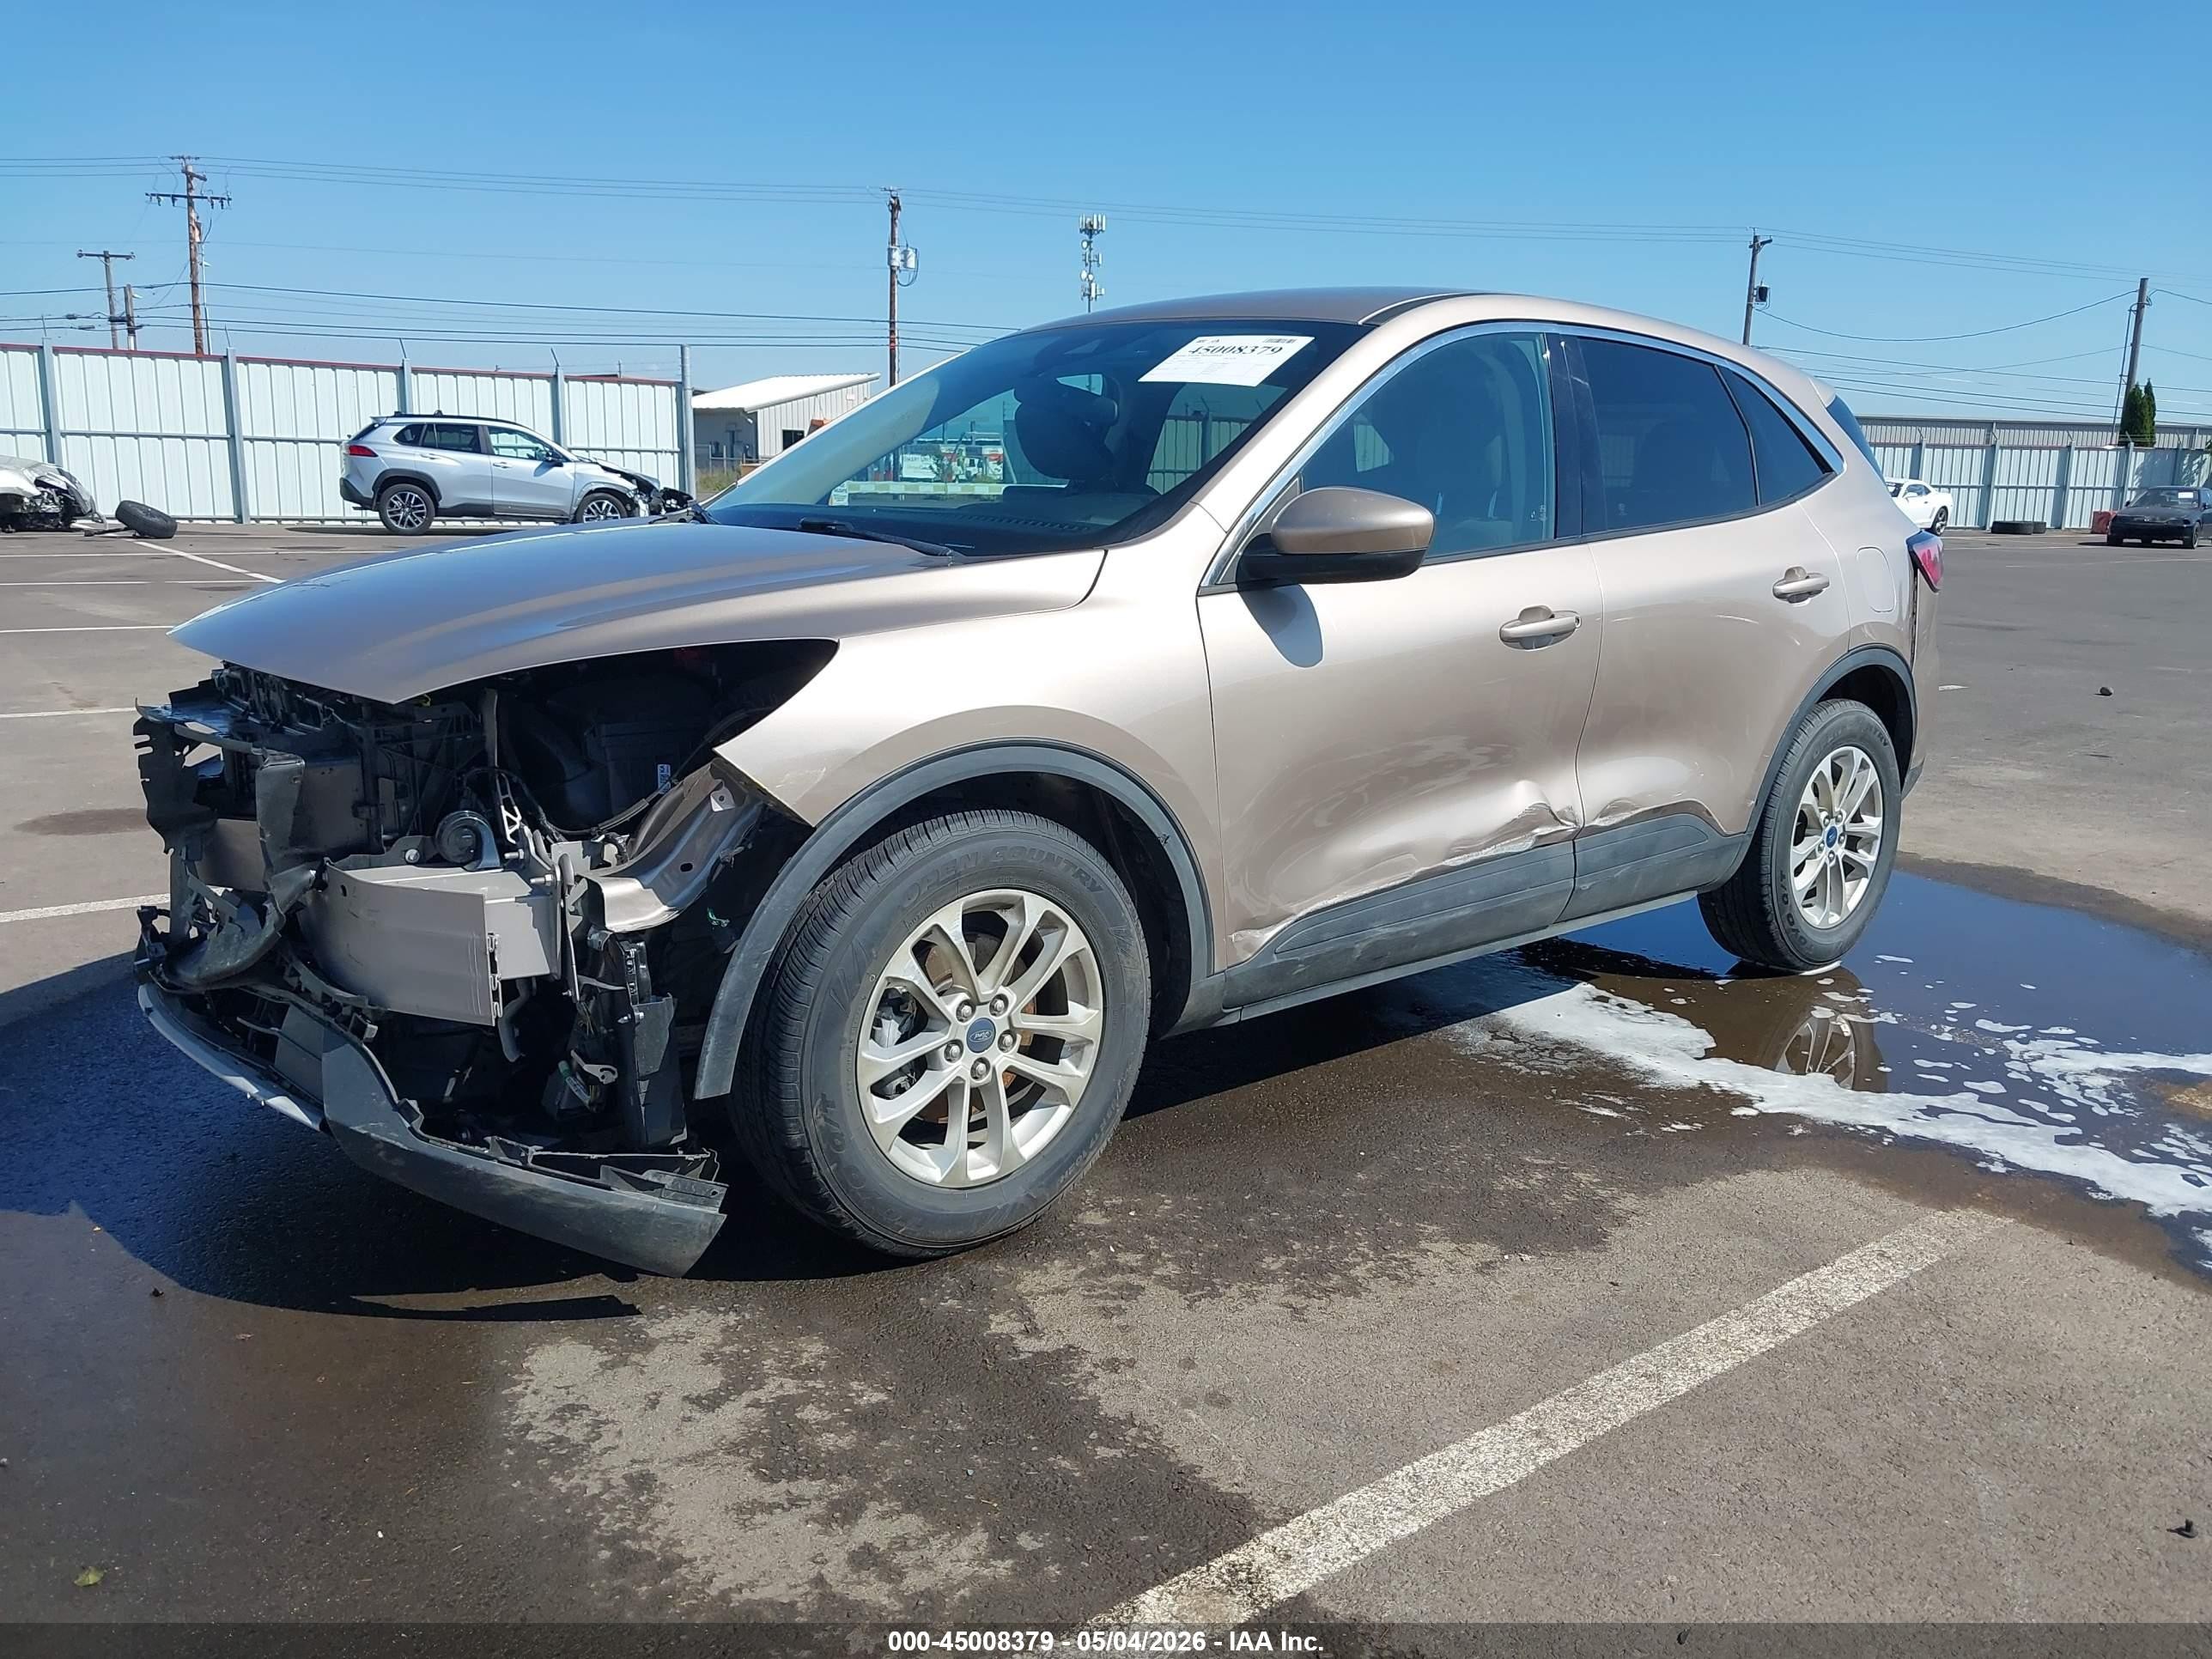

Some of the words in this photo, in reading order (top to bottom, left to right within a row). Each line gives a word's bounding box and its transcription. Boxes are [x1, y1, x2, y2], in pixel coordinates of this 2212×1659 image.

[1188, 345, 1283, 356] 45008379
[901, 851, 980, 908] OPEN
[988, 845, 1105, 894] COUNTRY
